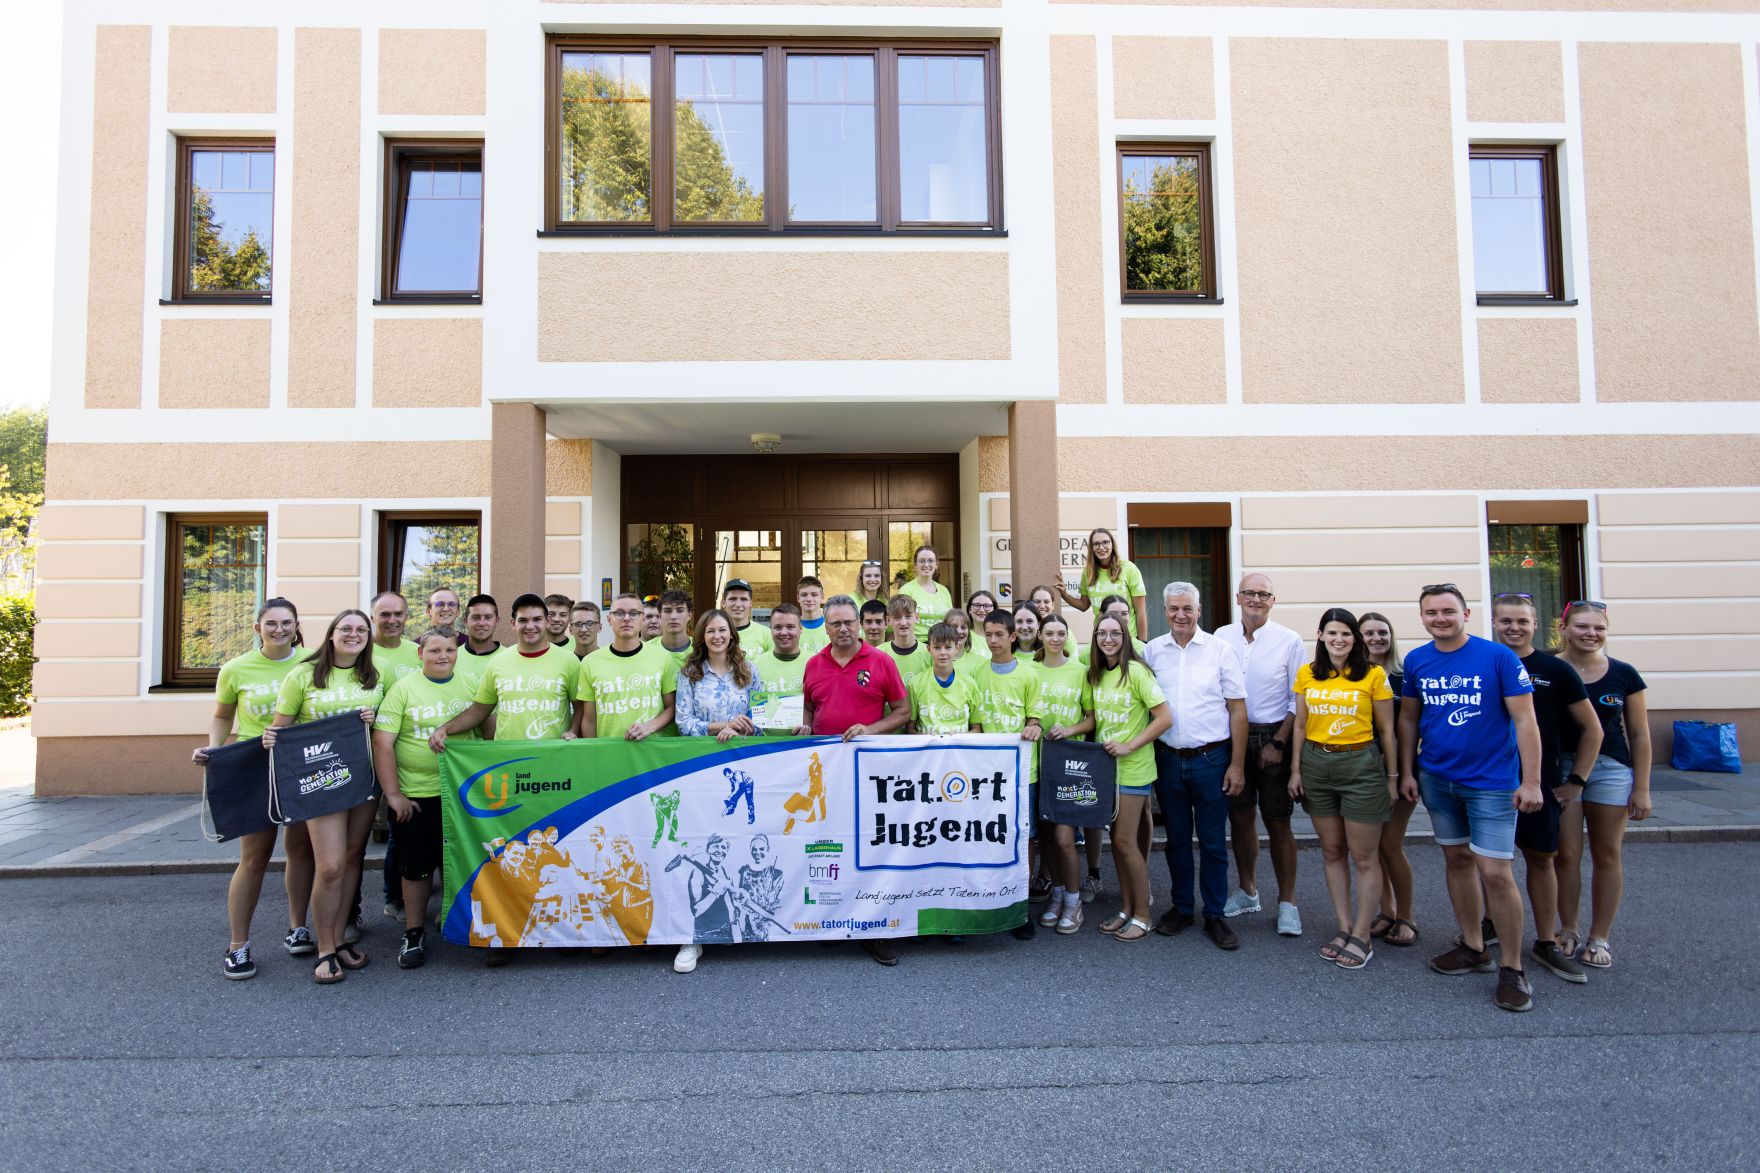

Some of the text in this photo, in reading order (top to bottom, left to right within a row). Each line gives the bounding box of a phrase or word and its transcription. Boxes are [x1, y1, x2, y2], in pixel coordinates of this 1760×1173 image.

[1422, 692, 1482, 706] Jugend
[515, 778, 571, 795] jugend
[870, 812, 1007, 848] Jugend
[855, 889, 913, 905] Landjugend
[916, 887, 945, 898] setzt
[949, 886, 980, 898] Taten
[982, 890, 996, 898] im
[999, 885, 1018, 896] Ort
[794, 917, 900, 931] www.tatortjugend.at
